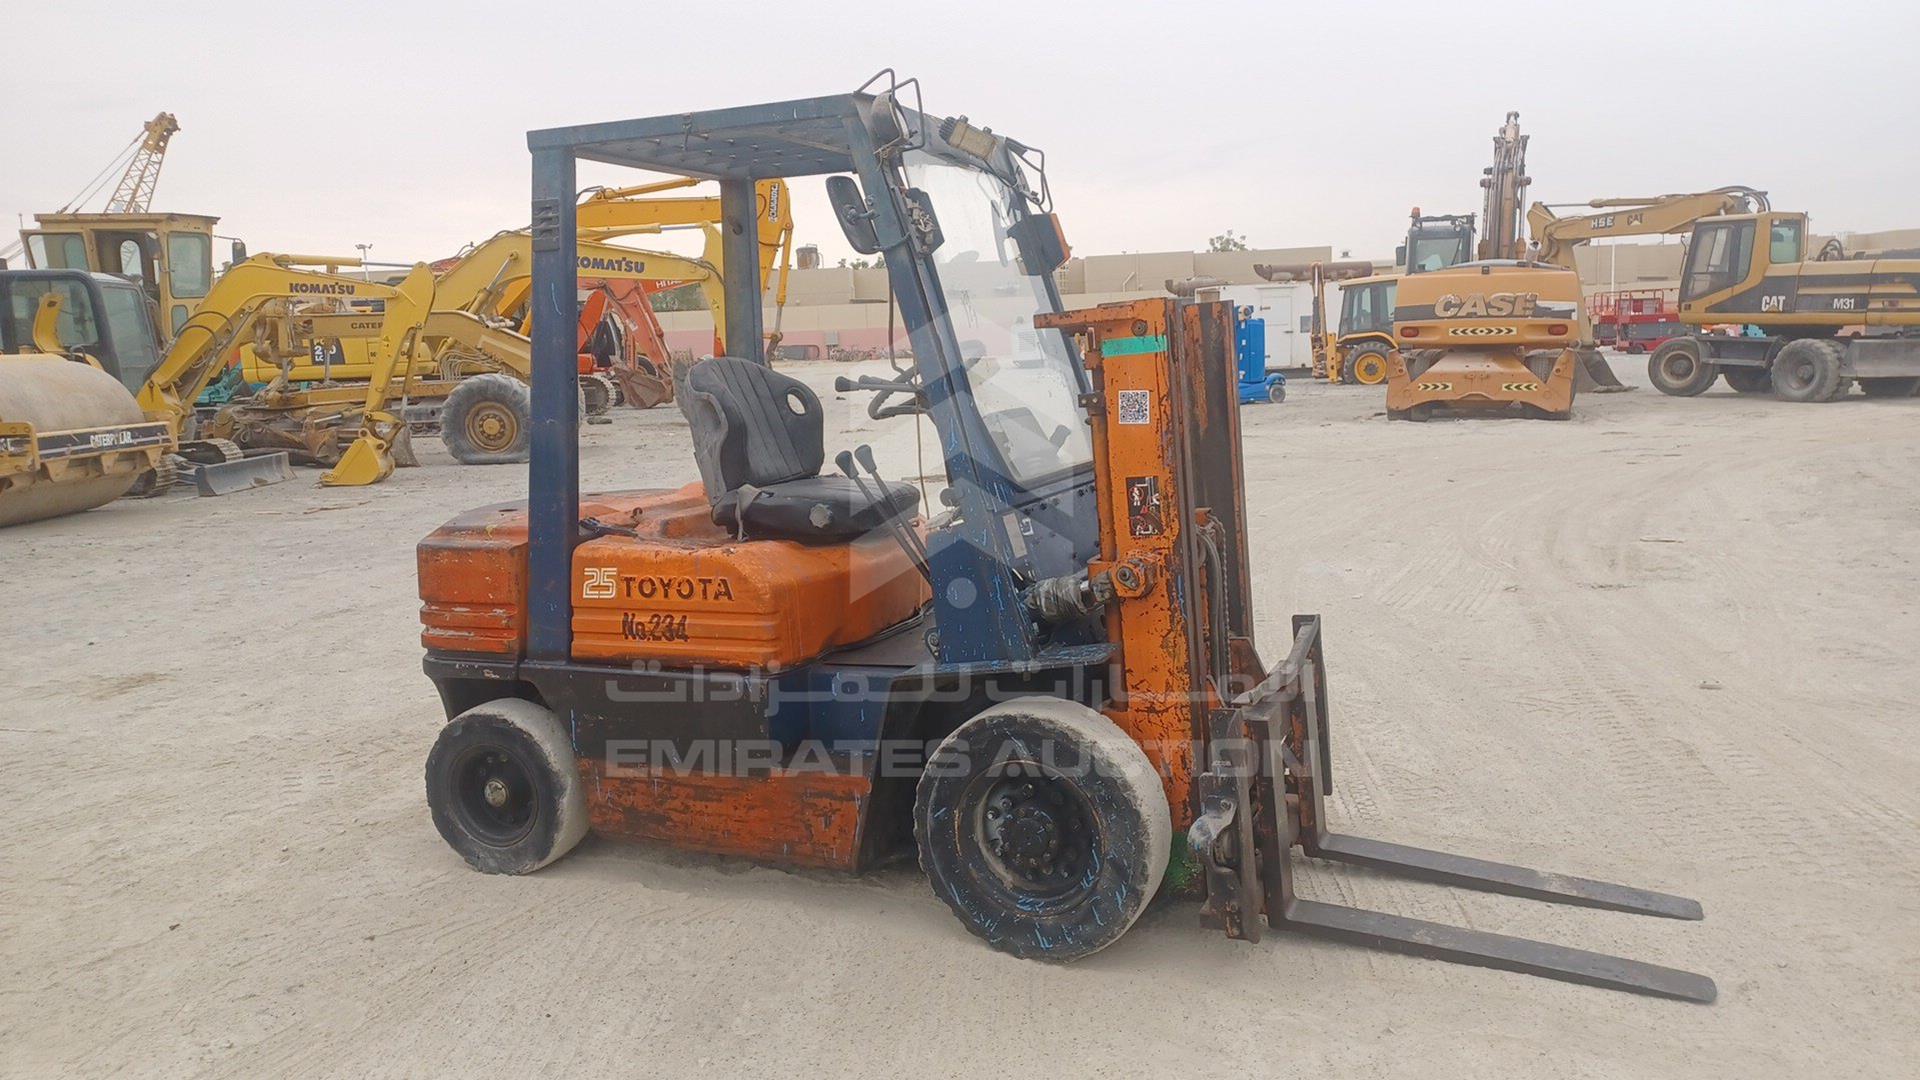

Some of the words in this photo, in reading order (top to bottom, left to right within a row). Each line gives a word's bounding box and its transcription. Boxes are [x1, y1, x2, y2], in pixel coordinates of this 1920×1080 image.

[289, 281, 355, 295] KOMATSU
[1434, 292, 1539, 318] CASE
[1761, 295, 1786, 312] CAT
[314, 345, 337, 355] 20
[583, 567, 618, 599] 25
[621, 575, 735, 601] TOYOTA
[622, 612, 690, 642] No.234
